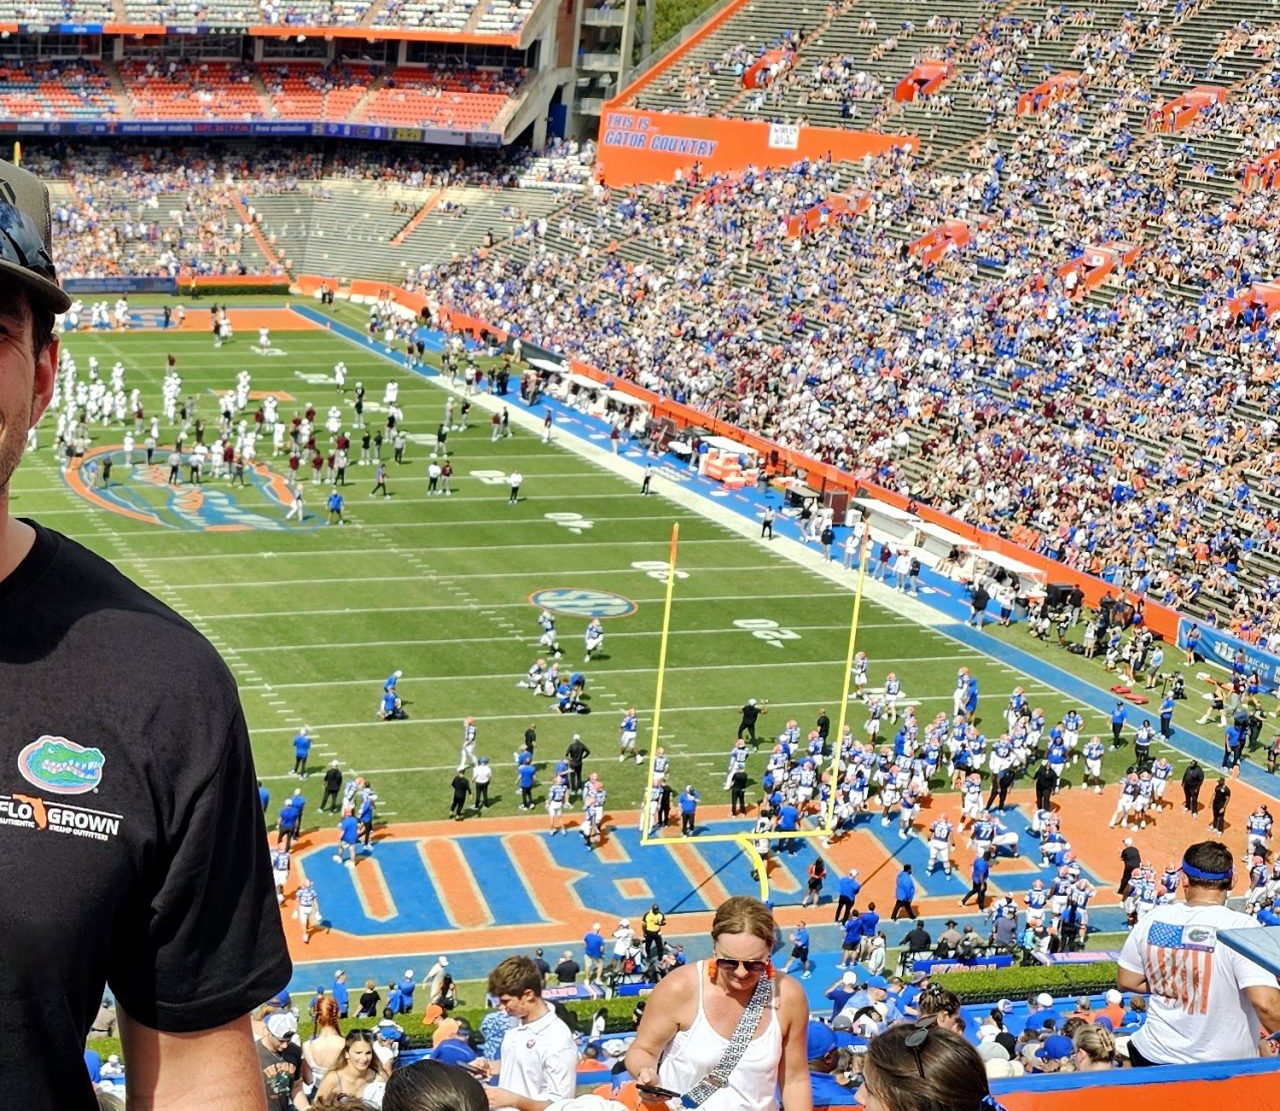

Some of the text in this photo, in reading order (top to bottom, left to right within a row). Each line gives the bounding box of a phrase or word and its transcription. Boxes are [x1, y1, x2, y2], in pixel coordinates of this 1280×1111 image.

[607, 114, 633, 128] THIS
[604, 130, 718, 157] GATOR COUNTRY
[47, 807, 120, 836] GROWN
[48, 824, 73, 834] SWAMP
[72, 829, 109, 841] OUTFITTERS
[979, 827, 992, 840] 77
